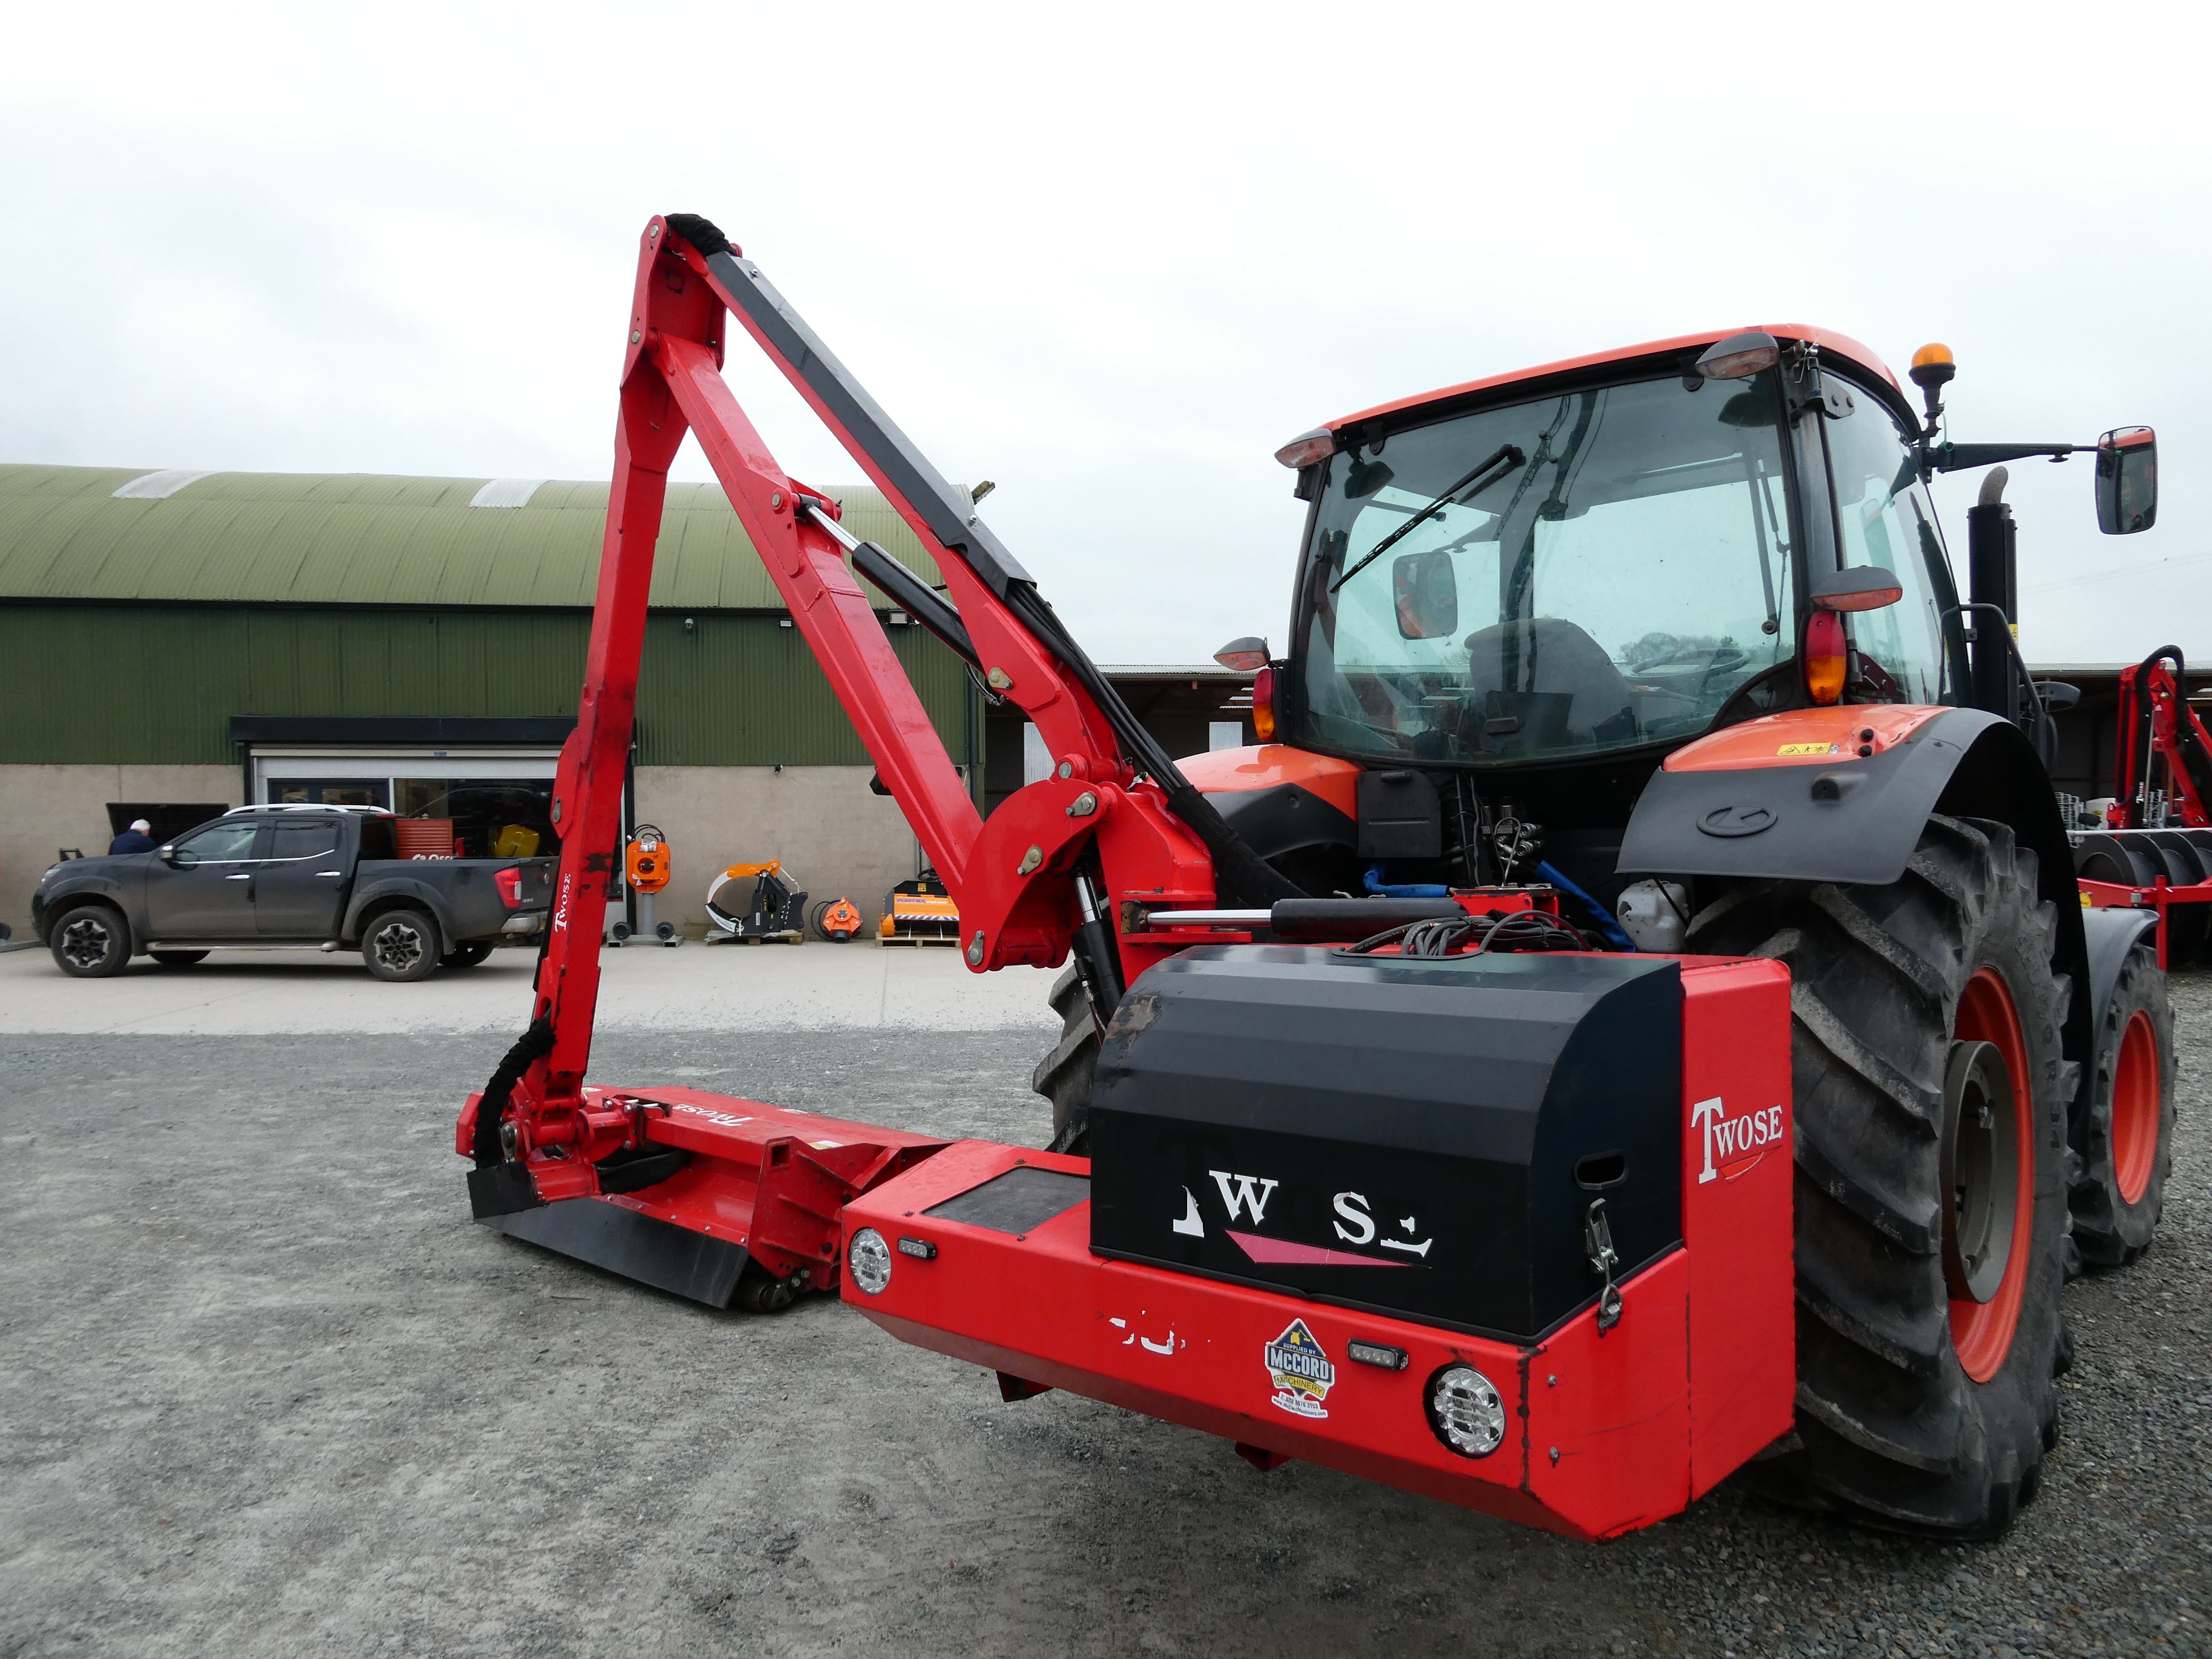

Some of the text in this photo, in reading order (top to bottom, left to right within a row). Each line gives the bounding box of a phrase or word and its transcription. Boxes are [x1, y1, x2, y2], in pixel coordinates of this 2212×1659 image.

[1691, 1097, 1783, 1184] TWOSE
[1283, 1343, 1307, 1353] SUPPLIED
[1276, 1377, 1323, 1394] MACHINERY
